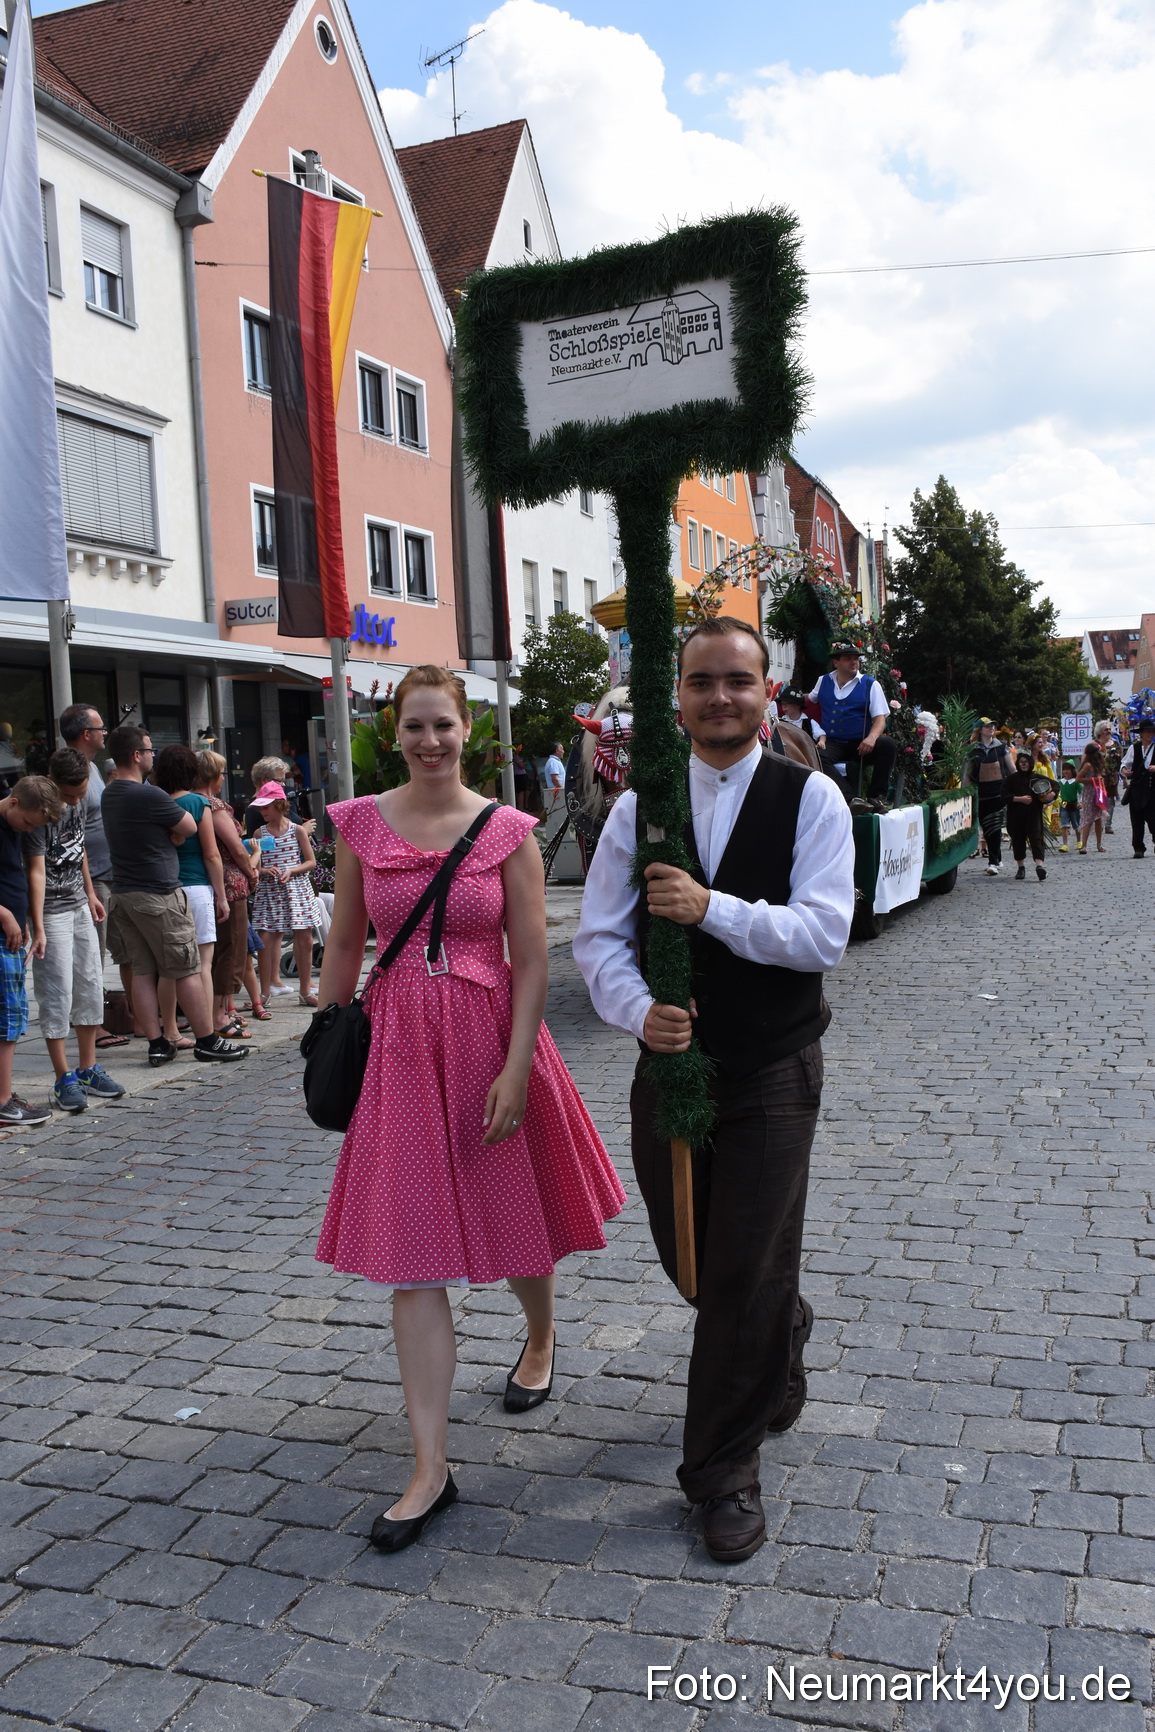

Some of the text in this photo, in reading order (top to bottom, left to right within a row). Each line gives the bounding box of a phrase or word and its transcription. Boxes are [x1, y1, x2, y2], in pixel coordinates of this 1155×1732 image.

[548, 317, 620, 341] Theaterverein
[549, 322, 662, 362] Schloßspiele
[551, 357, 604, 376] Neumarkt
[227, 603, 275, 621] sutor.
[350, 603, 397, 647] utor.
